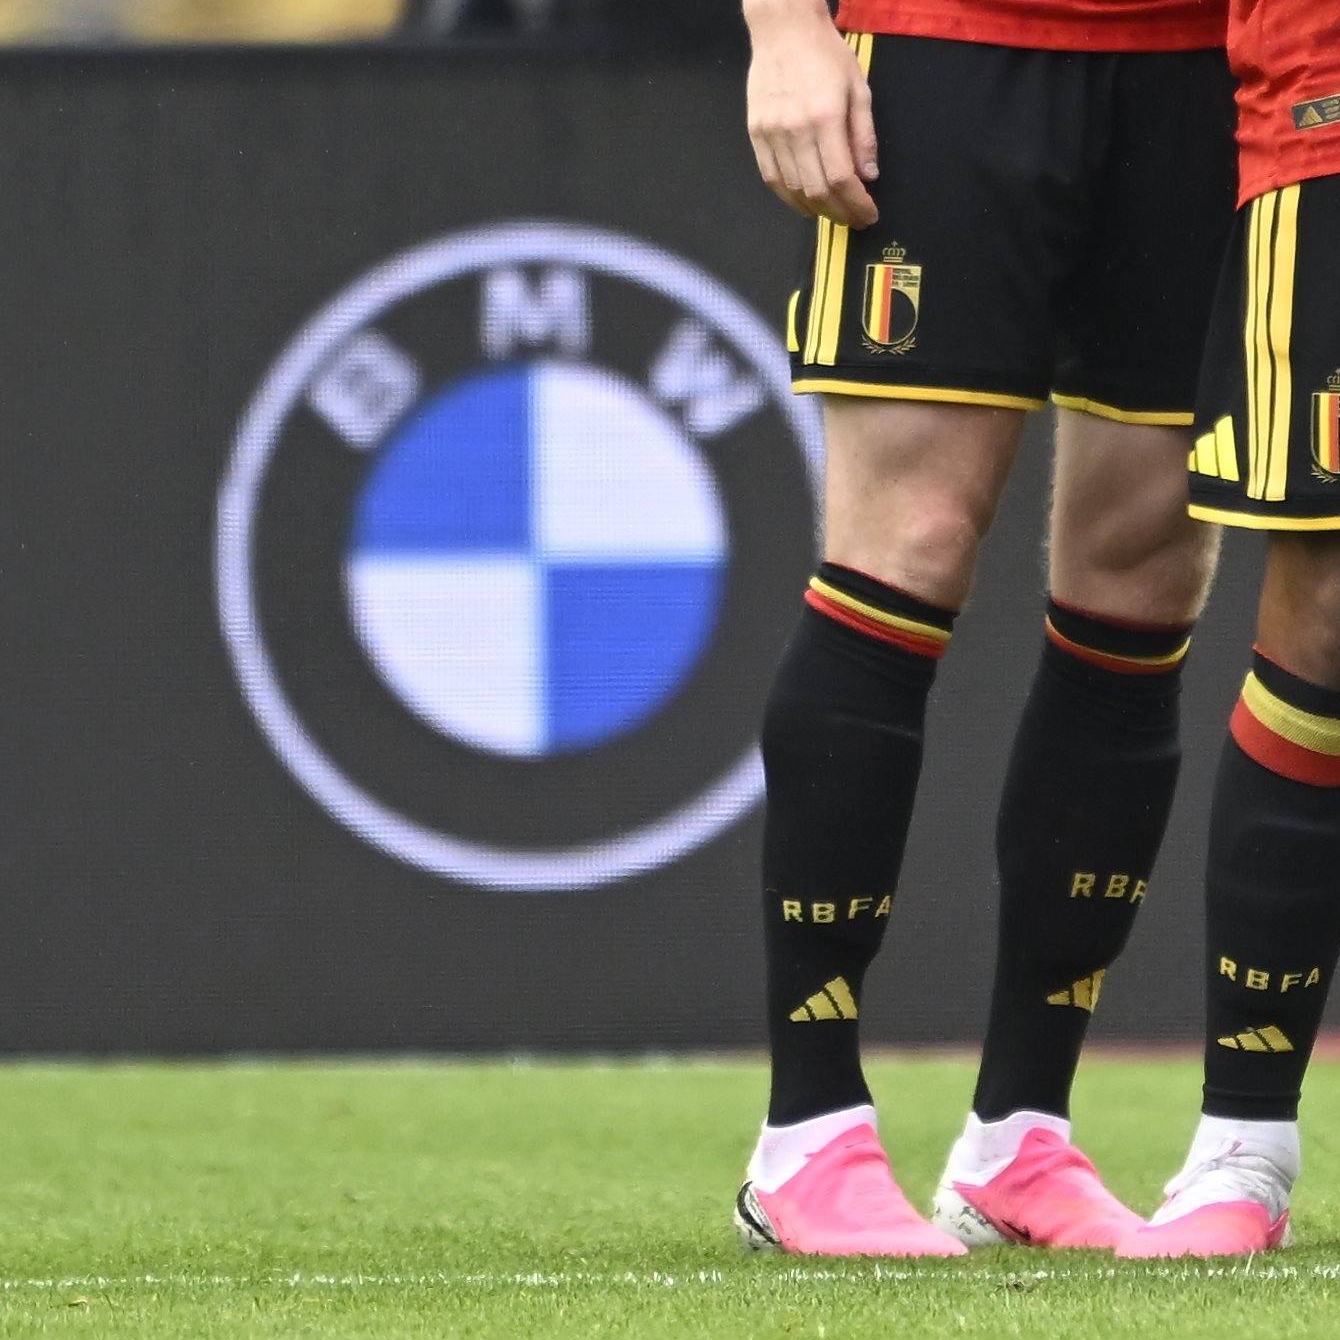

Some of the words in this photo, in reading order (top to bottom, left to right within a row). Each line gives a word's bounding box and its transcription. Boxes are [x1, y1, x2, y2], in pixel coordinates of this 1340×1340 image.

[306, 264, 768, 452] BMW
[1070, 872, 1148, 904] RBF
[782, 894, 892, 924] RBFA
[1219, 956, 1320, 993] RBFA
